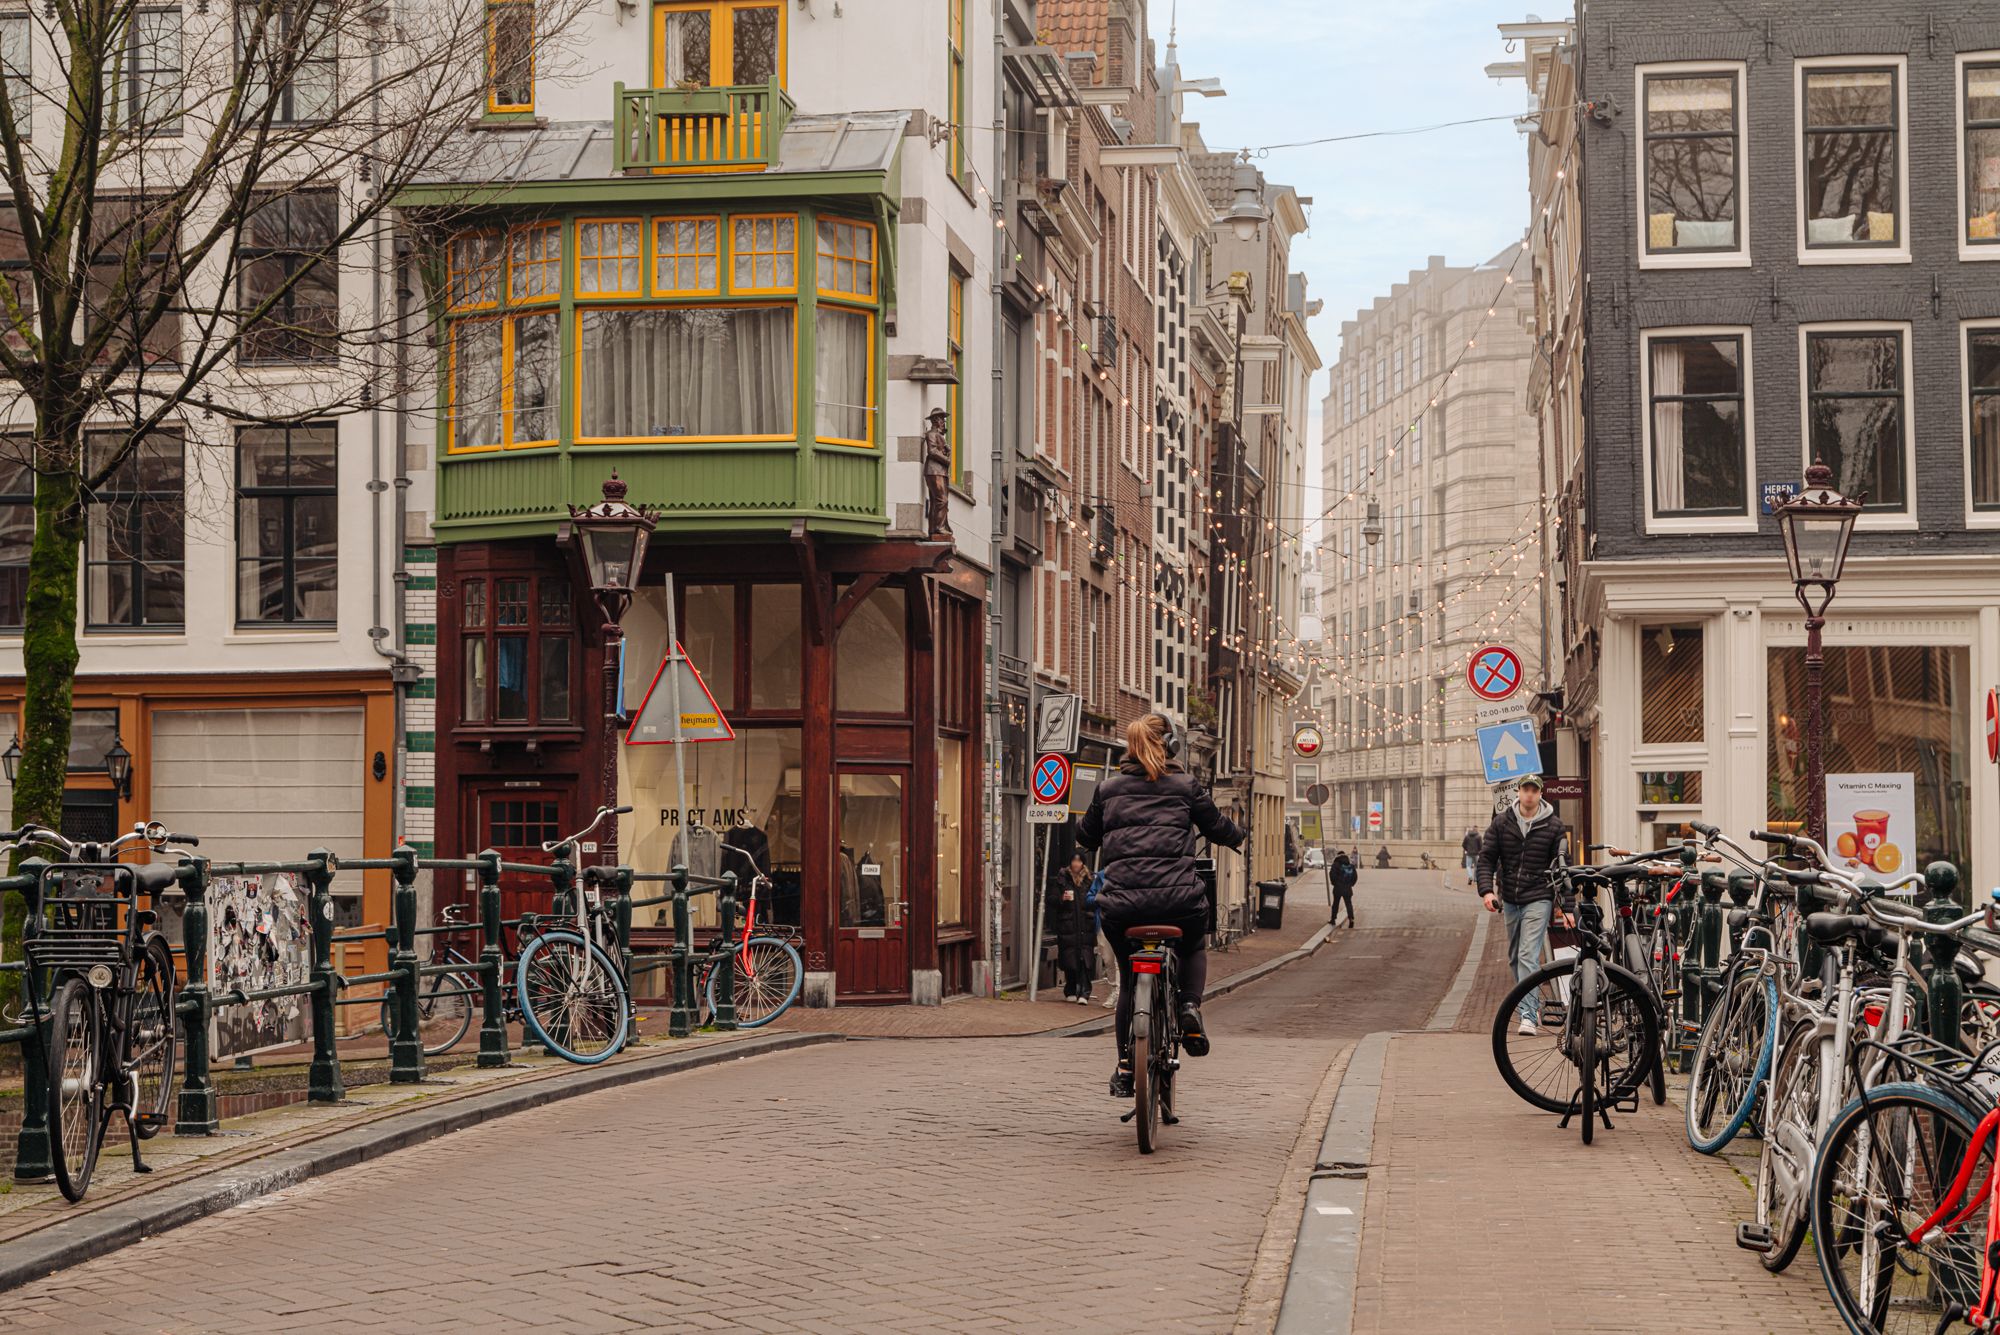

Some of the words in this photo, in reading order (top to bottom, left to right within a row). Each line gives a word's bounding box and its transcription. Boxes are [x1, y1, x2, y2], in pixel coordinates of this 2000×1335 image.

[1764, 484, 1794, 494] HEREN
[1480, 704, 1525, 718] 12.00-18.00h
[1493, 782, 1520, 794] uitgezon
[1546, 785, 1582, 795] meCHICas
[1838, 782, 1867, 790] Vitamin
[1874, 782, 1902, 790] Maxing
[660, 808, 706, 827] PRCT
